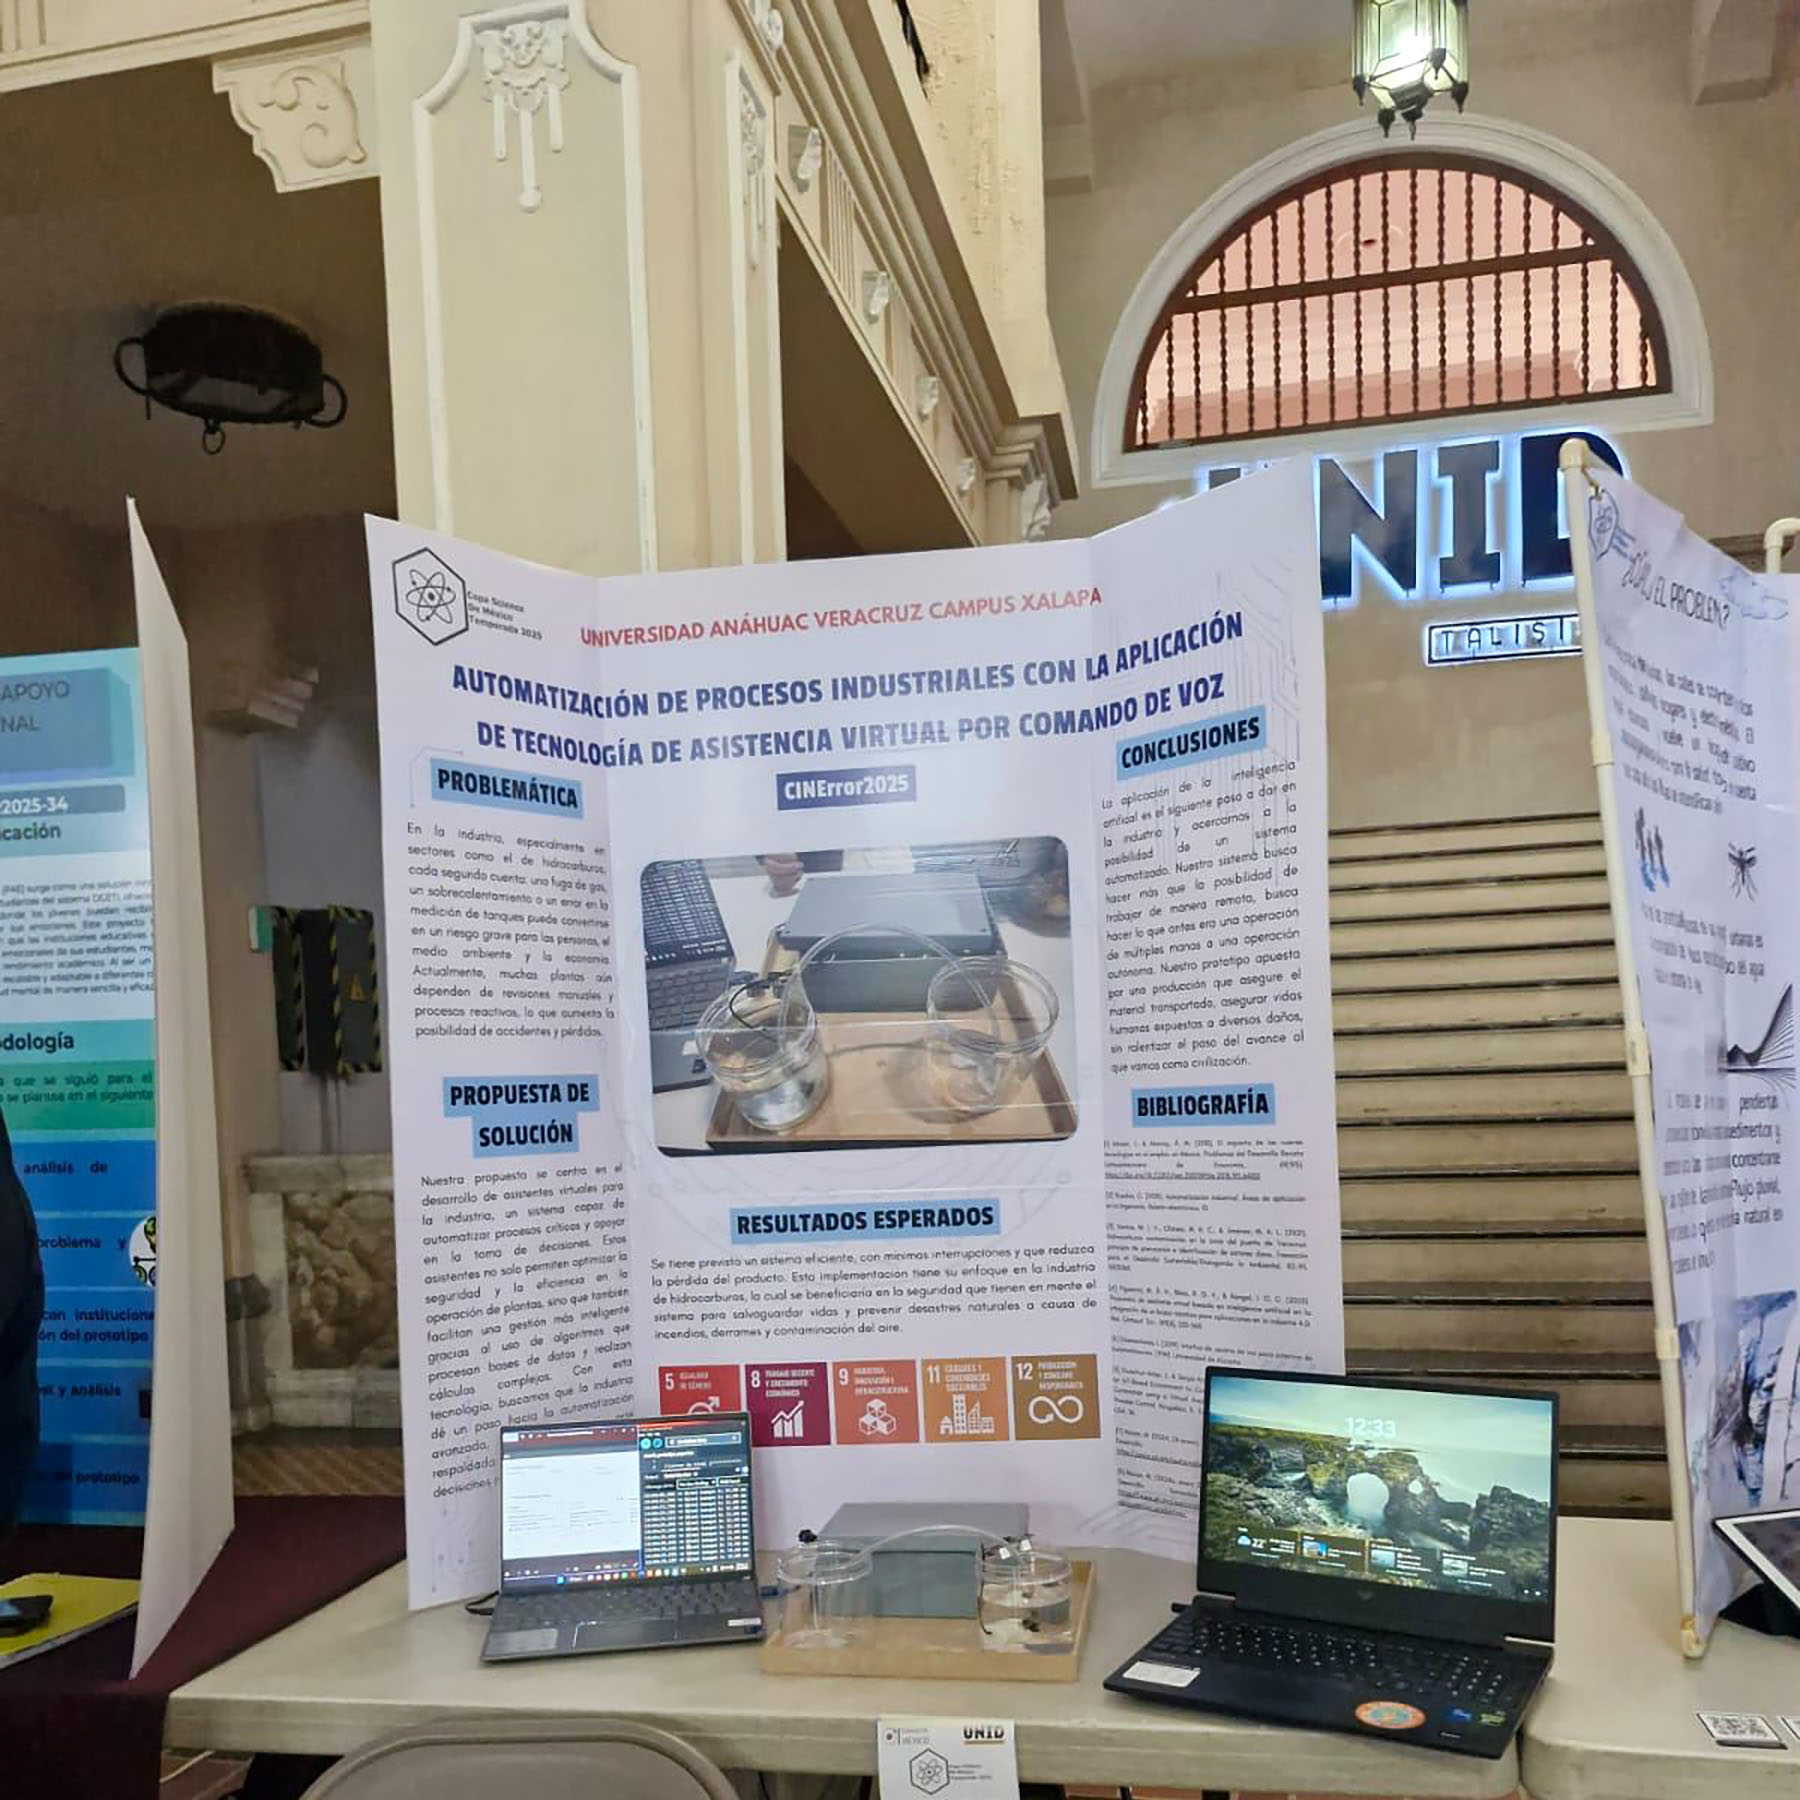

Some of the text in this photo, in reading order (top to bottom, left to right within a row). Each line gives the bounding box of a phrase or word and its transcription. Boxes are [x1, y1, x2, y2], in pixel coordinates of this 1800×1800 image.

[1208, 431, 1624, 600] NID
[581, 587, 1101, 648] UNIVERSIDAD ANÁHUAC VERACRUZ CAMPUS XALAPA
[453, 609, 1243, 719] AUTOMATIZACIÓN DE PROCESOS INDUSTRIALES CON LA APLICACIÓN
[2, 680, 70, 700] APOYO
[1, 715, 40, 733] NAL
[478, 672, 1225, 768] DE TECNOLOGÍA DE ASISTENCIA VIRTUAL POR COMANDO DE VOZ
[1120, 716, 1261, 771] CONCLUSIONES
[438, 768, 578, 809] PROBLEMÁTICA
[783, 773, 910, 801] CINError2025
[0, 796, 69, 814] 2025-34
[407, 822, 422, 835] En
[434, 824, 445, 837] la
[458, 829, 504, 844] industria,
[408, 846, 534, 866] sectores como el de
[1167, 883, 1186, 896] que
[1195, 879, 1205, 890] la
[1283, 865, 1298, 877] de
[465, 908, 479, 919] de
[1255, 949, 1300, 965] apuesta
[413, 965, 486, 979] Actualmente,
[1213, 978, 1233, 991] que
[1291, 968, 1301, 980] el
[416, 1024, 476, 1038] posibilidad
[479, 1024, 493, 1036] de
[1223, 1035, 1240, 1047] del
[1246, 1033, 1286, 1045] avance
[1293, 1029, 1304, 1042] al
[450, 1083, 590, 1106] PROPUESTA DE
[1137, 1088, 1269, 1117] BIBLIOGRAFÍA
[479, 1119, 573, 1147] SOLUCIÓN
[421, 1192, 478, 1207] desarrollo
[483, 1192, 497, 1201] de
[602, 1182, 623, 1193] para
[422, 1215, 433, 1226] la
[445, 1212, 495, 1225] industria,
[505, 1210, 518, 1219] un
[612, 1200, 624, 1210] de
[736, 1206, 994, 1235] RESULTADOS ESPERADOS
[651, 1258, 665, 1269] Se
[669, 1258, 695, 1269] tiene
[744, 1257, 758, 1266] un
[1015, 1248, 1021, 1258] y
[1024, 1247, 1045, 1258] que
[1048, 1243, 1095, 1255] reduzca
[654, 1311, 694, 1323] sistema
[701, 1311, 726, 1323] para
[1027, 1302, 1034, 1311] a
[1041, 1300, 1075, 1309] causa
[1082, 1298, 1097, 1308] de
[428, 1366, 480, 1383] procesan
[488, 1358, 519, 1373] bases
[527, 1356, 540, 1366] de
[751, 1370, 761, 1388] 8
[839, 1368, 849, 1386] 9
[926, 1365, 940, 1385] 11
[1016, 1363, 1033, 1380] 12
[665, 1373, 674, 1391] 5
[1345, 1417, 1397, 1437] 12:33
[964, 1725, 1004, 1739] UNID
